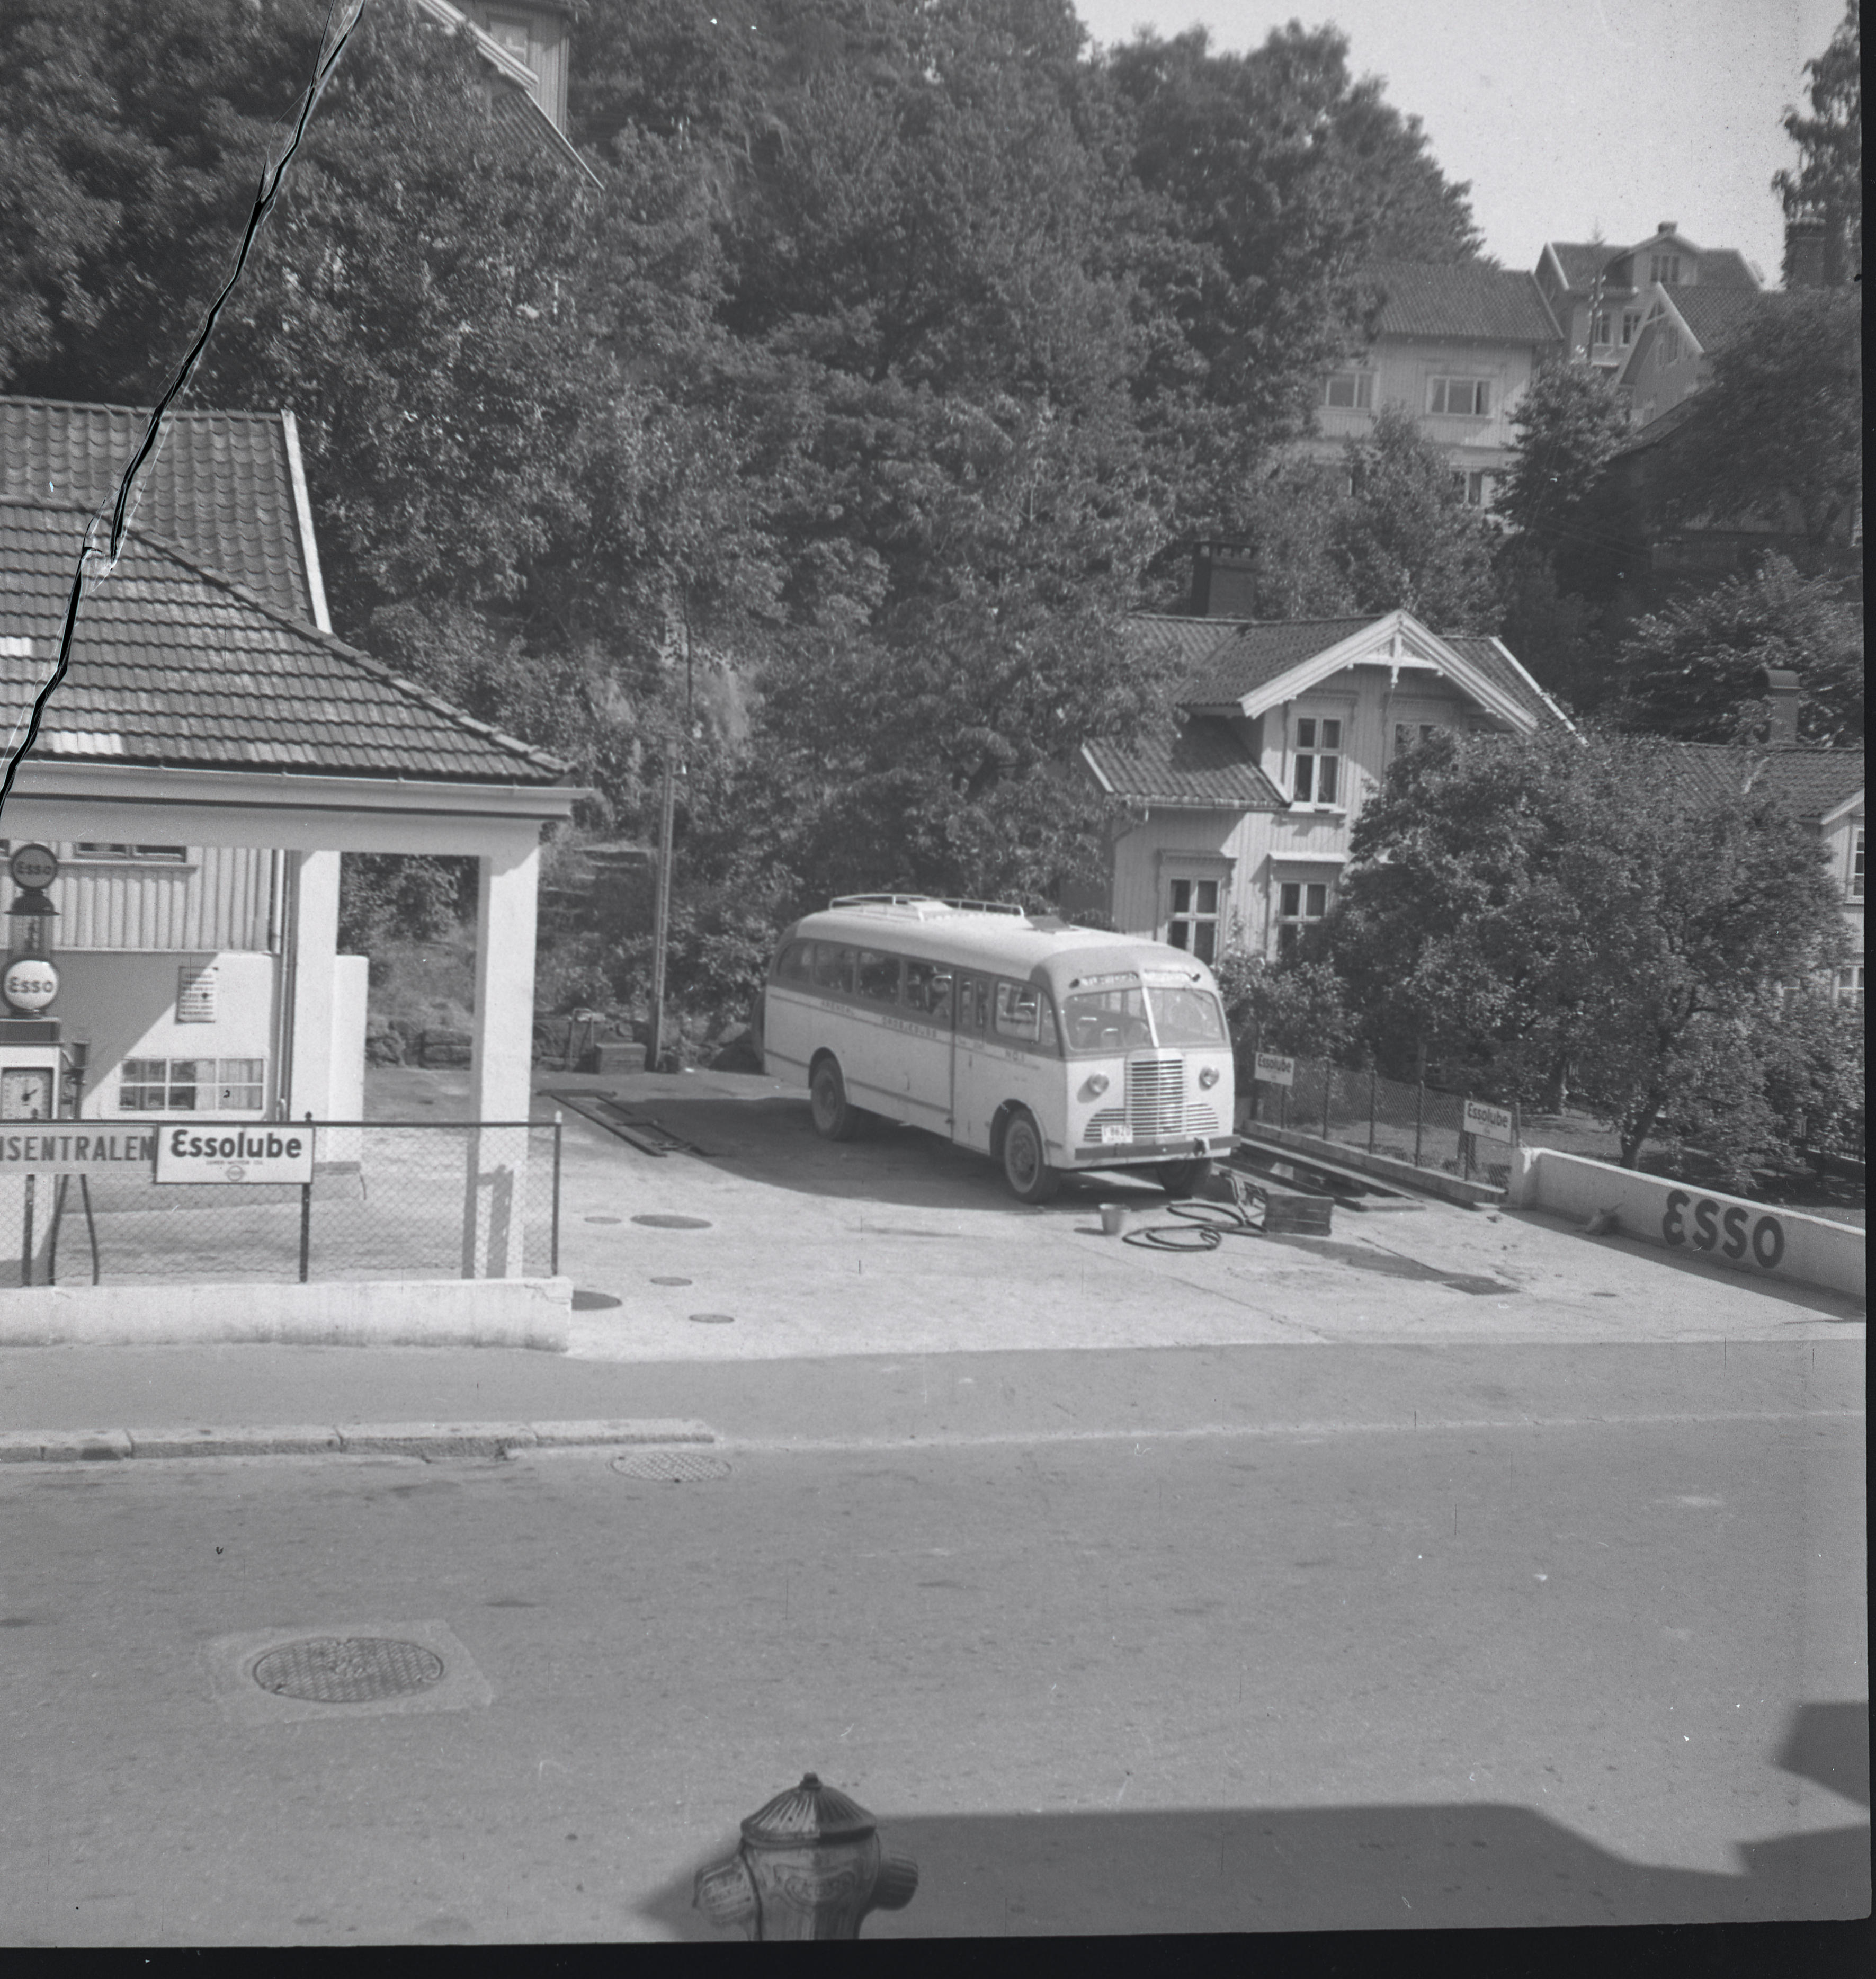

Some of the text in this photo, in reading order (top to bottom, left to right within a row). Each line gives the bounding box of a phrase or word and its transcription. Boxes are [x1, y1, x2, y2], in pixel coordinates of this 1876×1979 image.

[17, 861, 51, 876] Esso
[9, 976, 53, 993] Esso
[1258, 1053, 1291, 1074] Essolube
[1467, 1102, 1508, 1128] Essolube
[171, 1129, 302, 1158] Essolube
